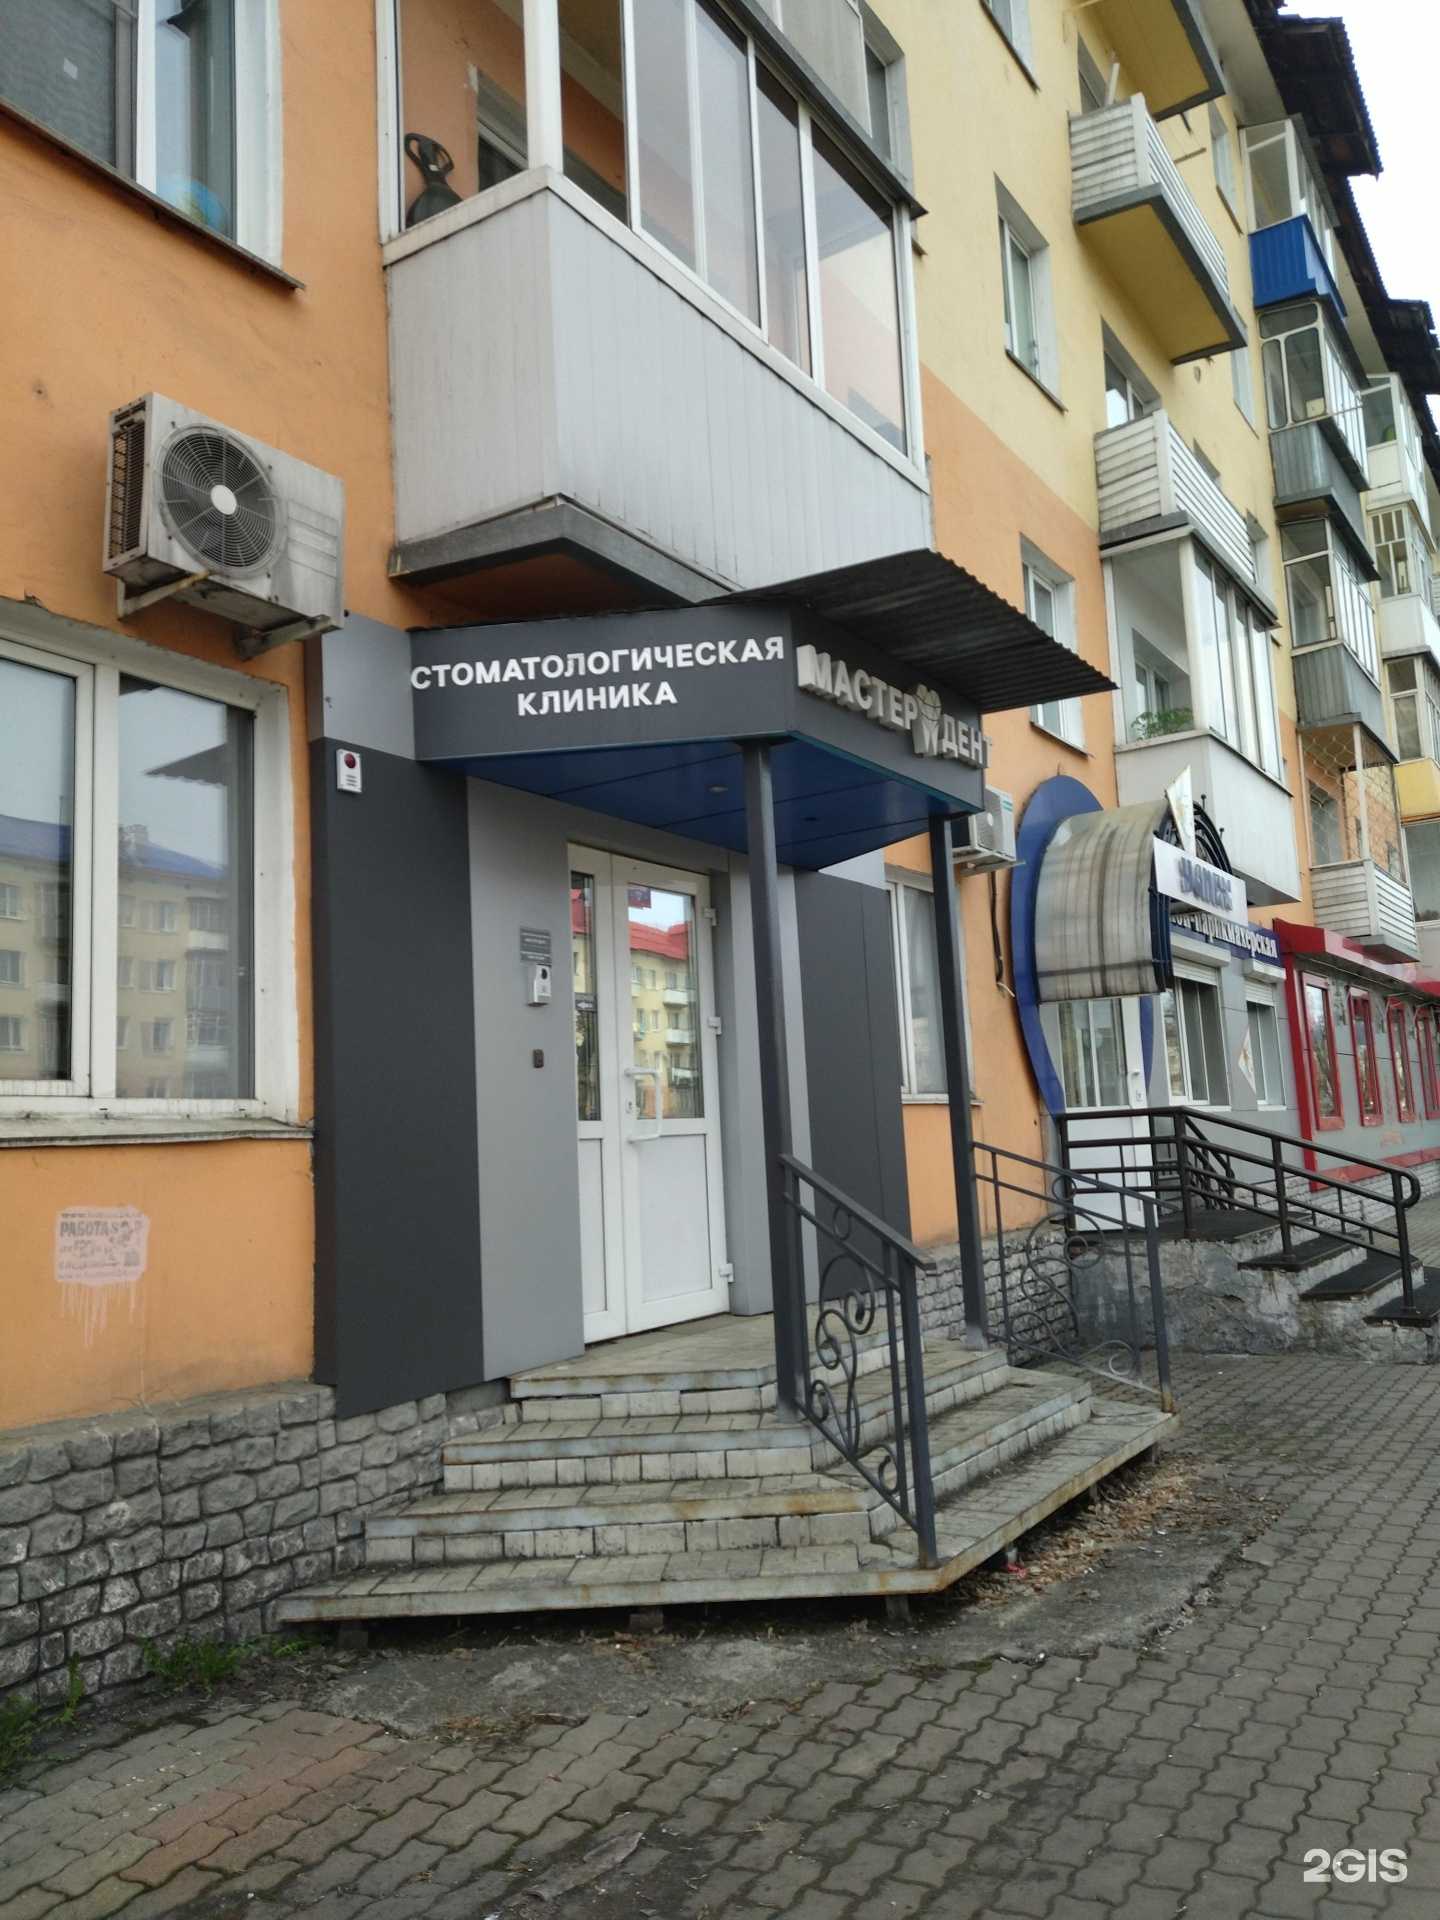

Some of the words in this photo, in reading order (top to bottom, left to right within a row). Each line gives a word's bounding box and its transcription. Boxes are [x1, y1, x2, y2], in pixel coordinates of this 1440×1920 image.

[410, 636, 784, 689] СТОМАТОЛОГИЧЕСКАЯ
[518, 681, 678, 716] КЛИНИКА
[797, 644, 918, 732] МАСТЕР
[941, 713, 992, 769] ДЕНТ
